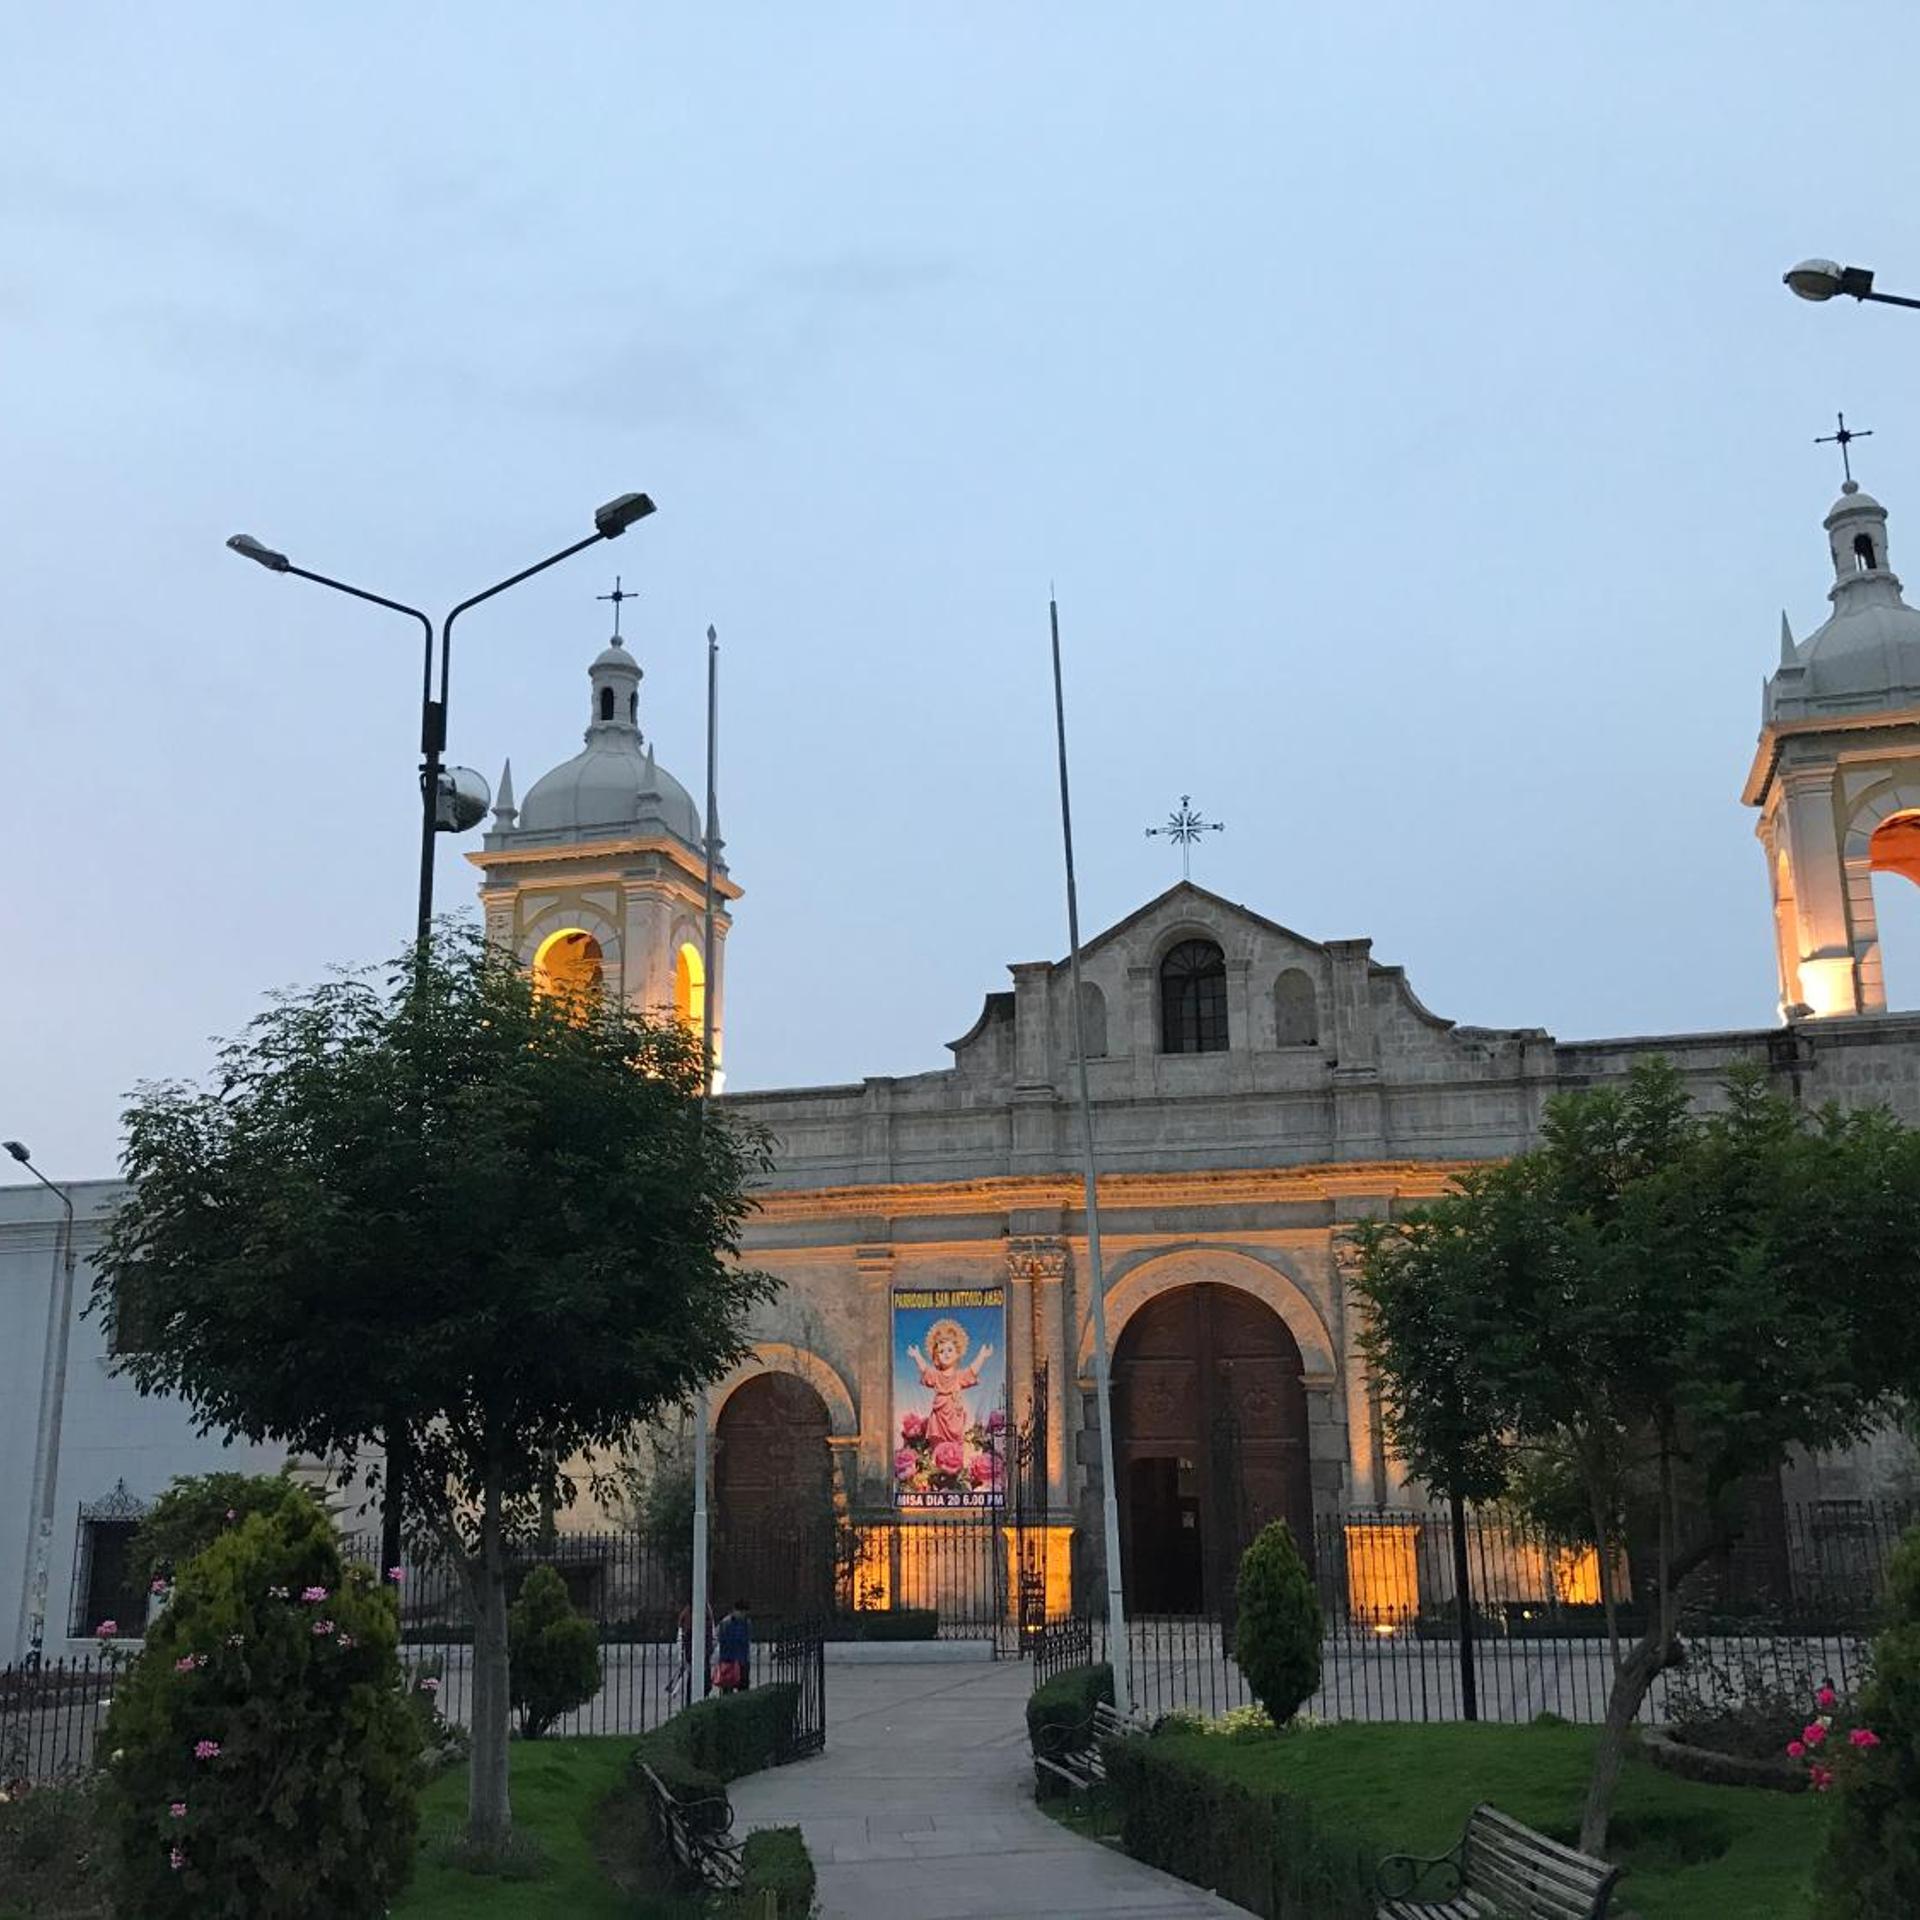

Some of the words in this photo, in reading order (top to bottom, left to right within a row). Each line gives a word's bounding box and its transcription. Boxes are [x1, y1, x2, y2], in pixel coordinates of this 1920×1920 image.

[934, 1291, 950, 1308] SAN
[951, 1290, 983, 1307] ANTONIO
[896, 1494, 924, 1506] MISA
[926, 1494, 945, 1506] DIA
[947, 1494, 960, 1506] 20
